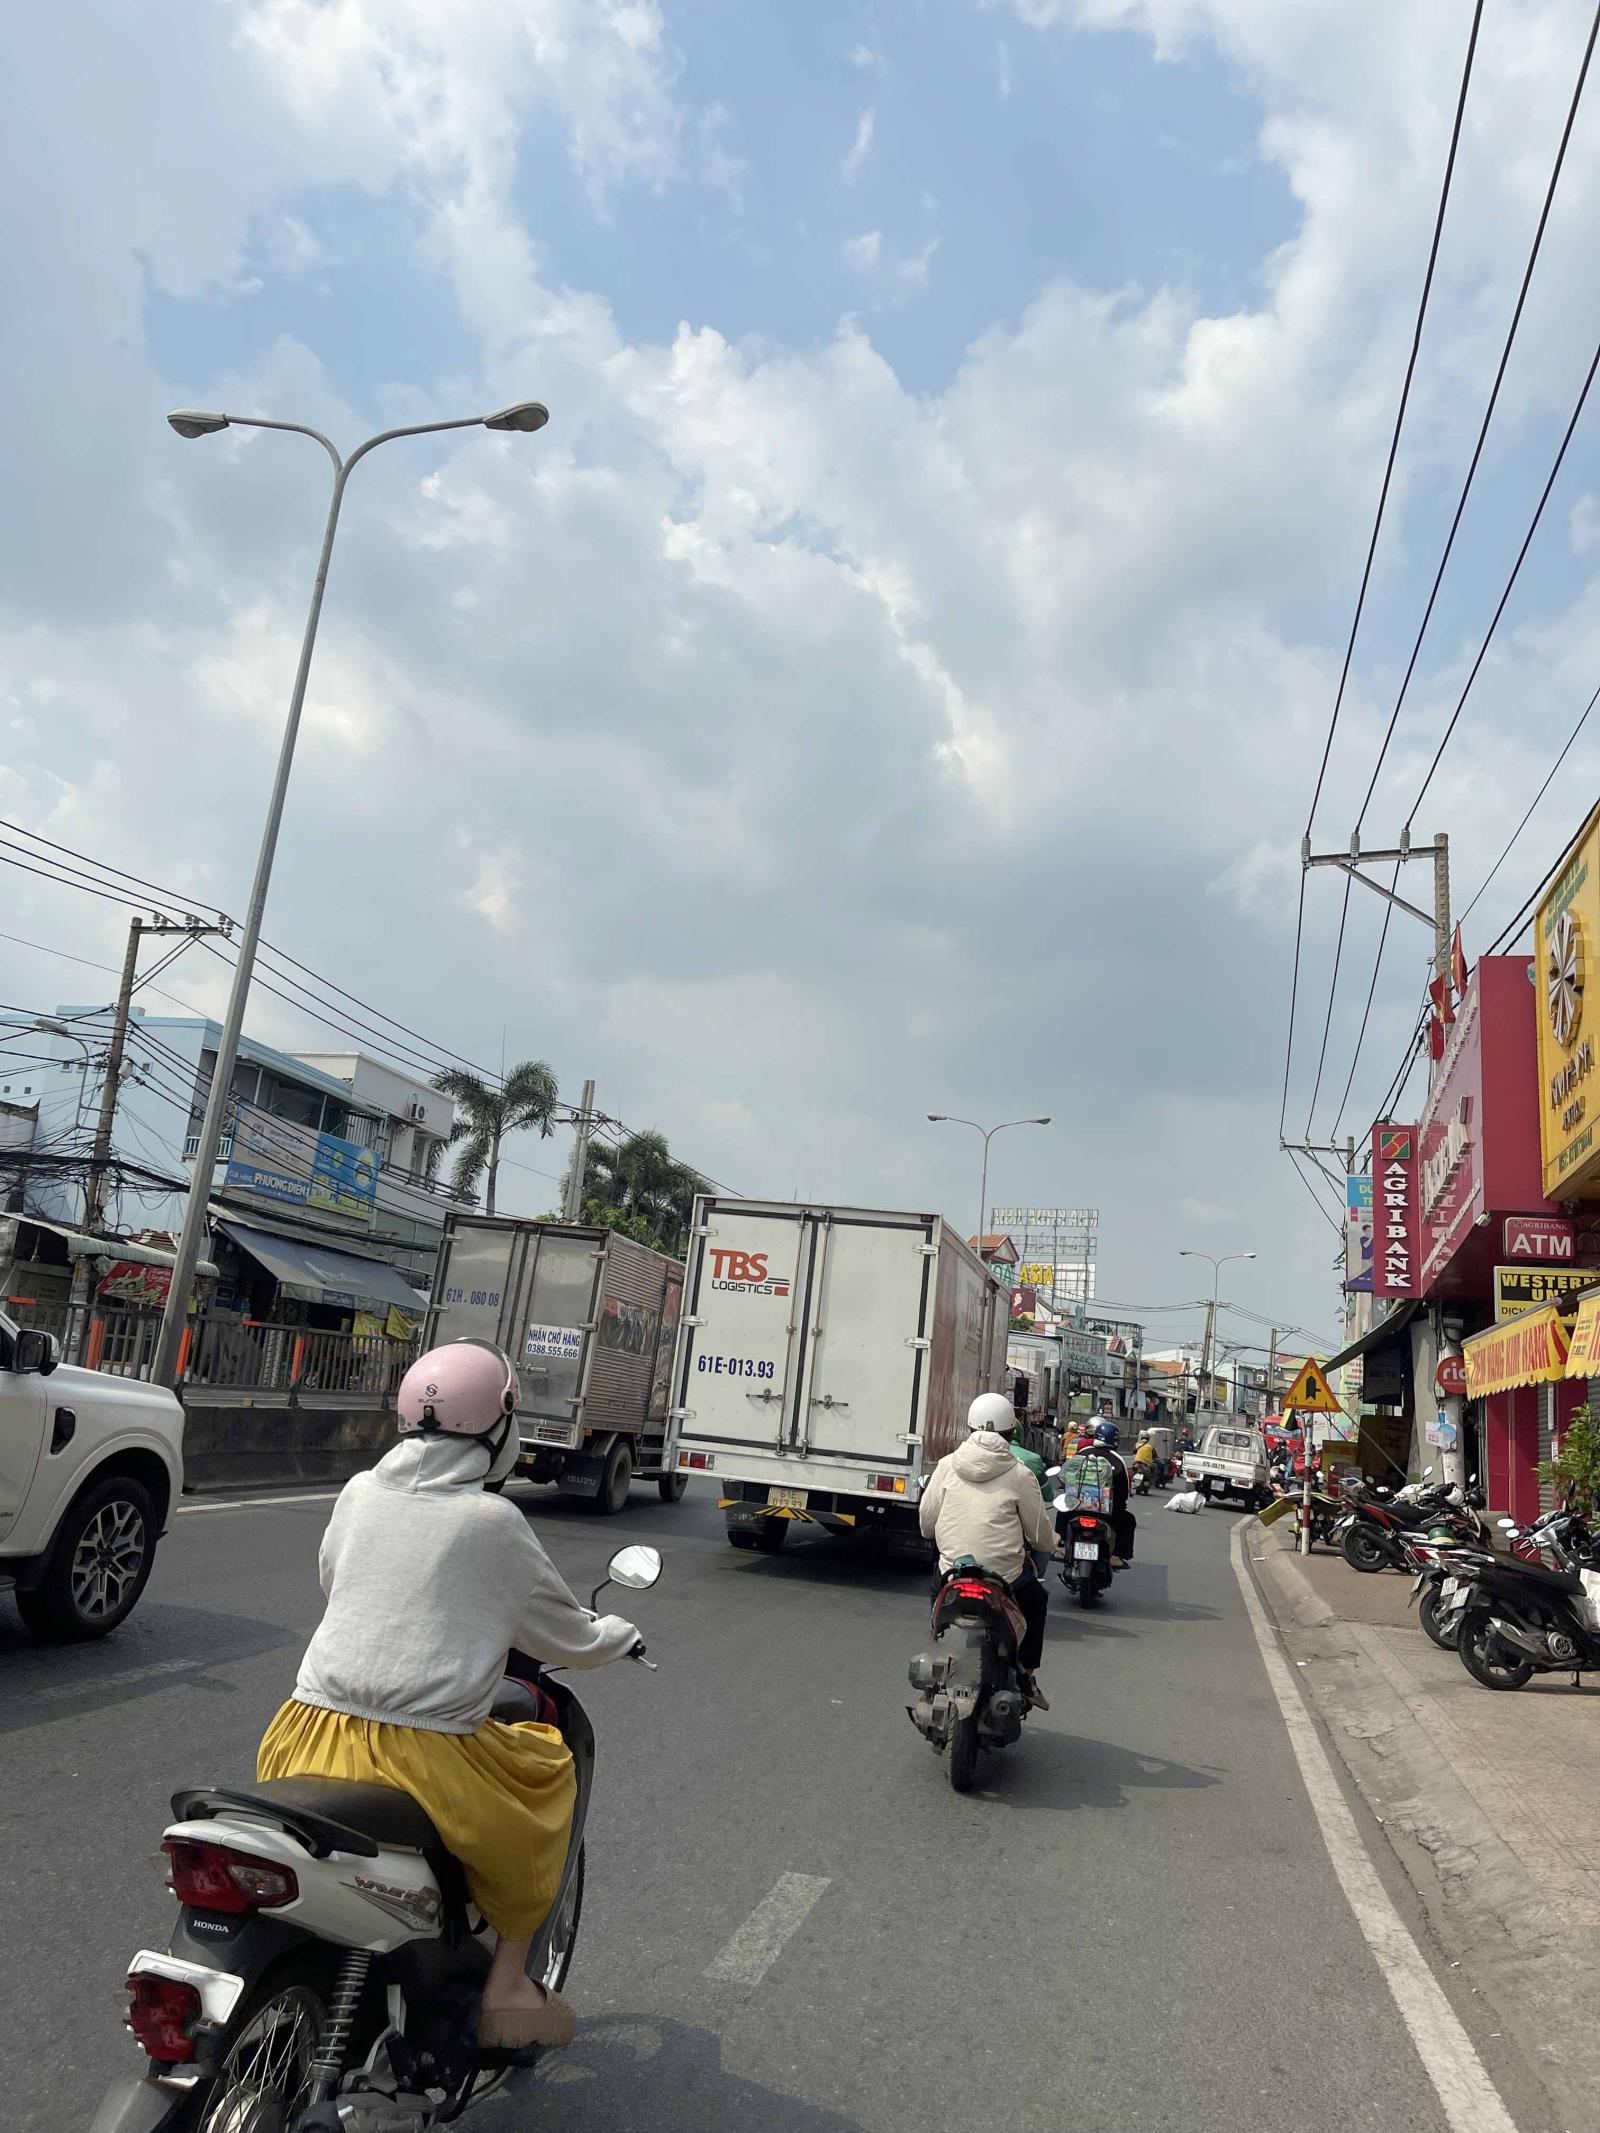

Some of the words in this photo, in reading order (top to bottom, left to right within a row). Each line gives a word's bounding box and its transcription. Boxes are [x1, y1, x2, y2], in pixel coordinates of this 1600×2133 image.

[1383, 1162, 1412, 1288] AGRIBANK
[1521, 1222, 1568, 1231] AGRIBANK
[1511, 1233, 1571, 1257] ATM
[709, 1248, 769, 1283] TBS
[1020, 1263, 1055, 1285] ASIA
[712, 1280, 773, 1295] LOGISTICS
[527, 1343, 579, 1358] 0388.555.666
[697, 1354, 775, 1379] 61E-013.93
[193, 1919, 230, 1933] HONDA
